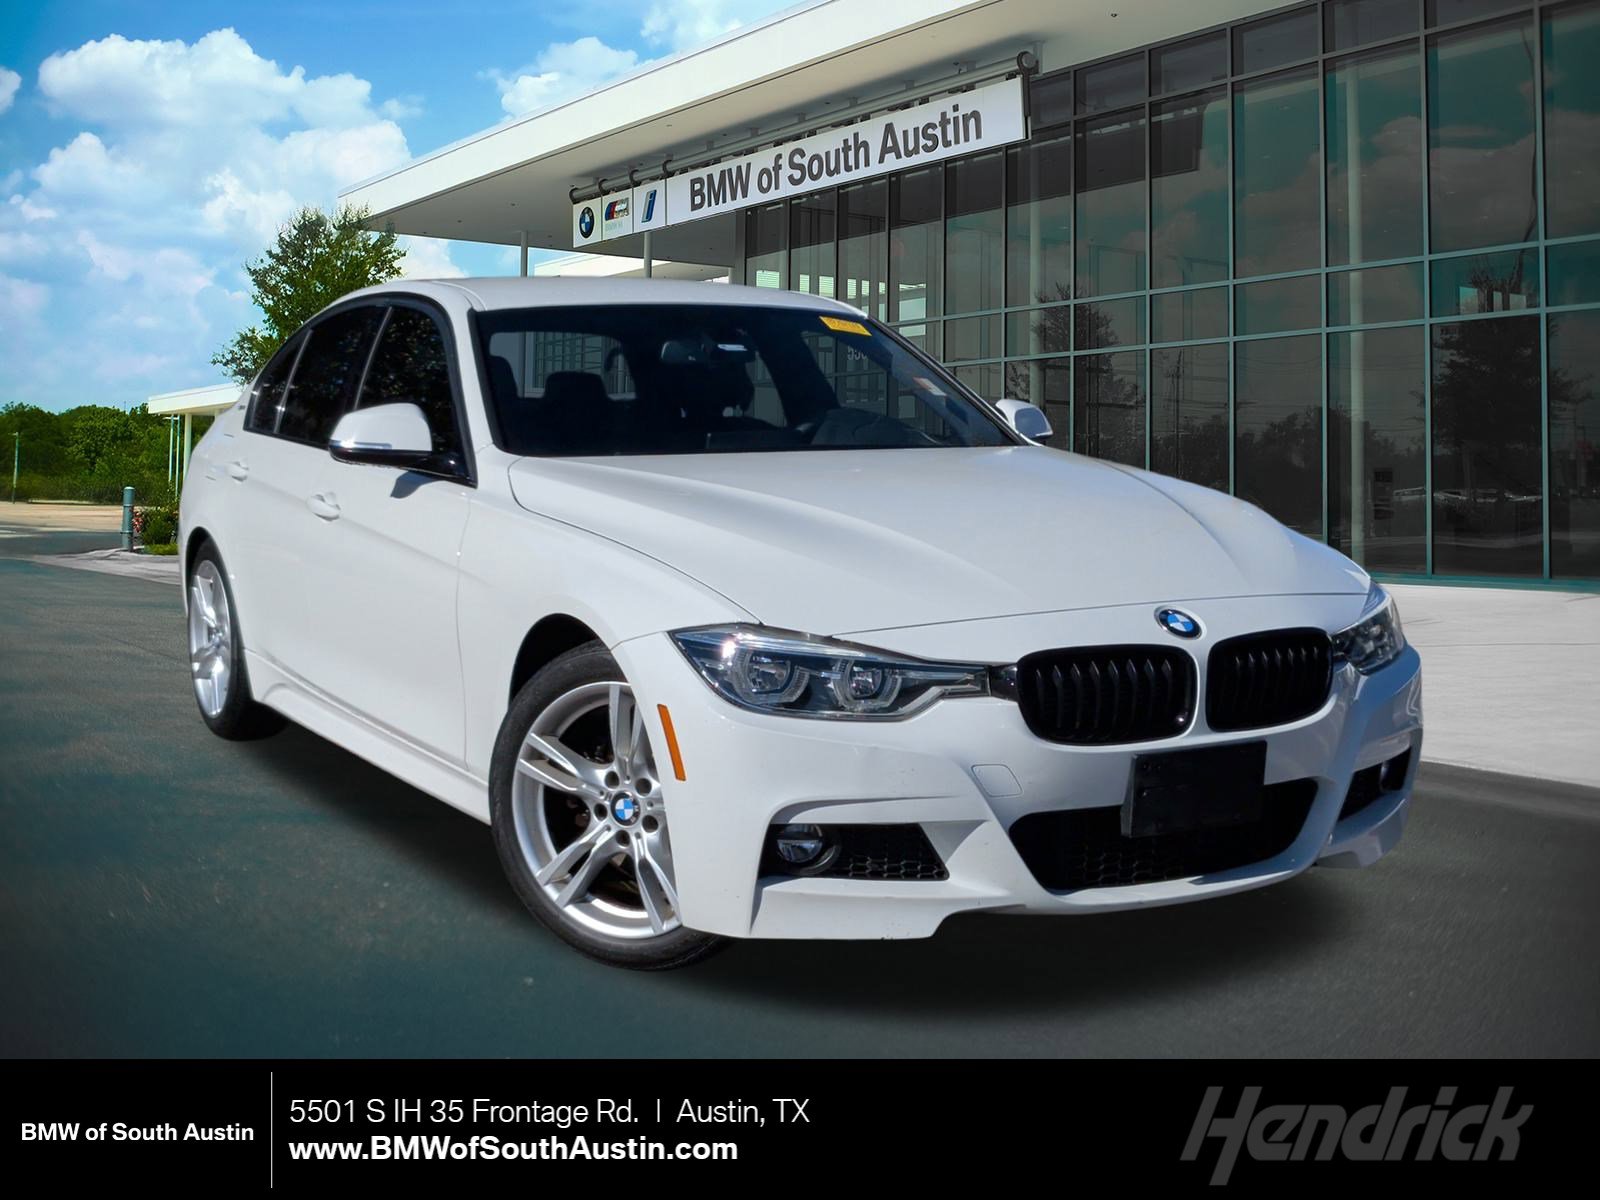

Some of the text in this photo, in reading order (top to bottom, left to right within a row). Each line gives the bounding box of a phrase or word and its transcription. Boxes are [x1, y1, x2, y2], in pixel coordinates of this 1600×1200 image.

[690, 162, 751, 212] BMW
[757, 153, 783, 194] of
[787, 131, 871, 187] South
[878, 103, 982, 164] Austin
